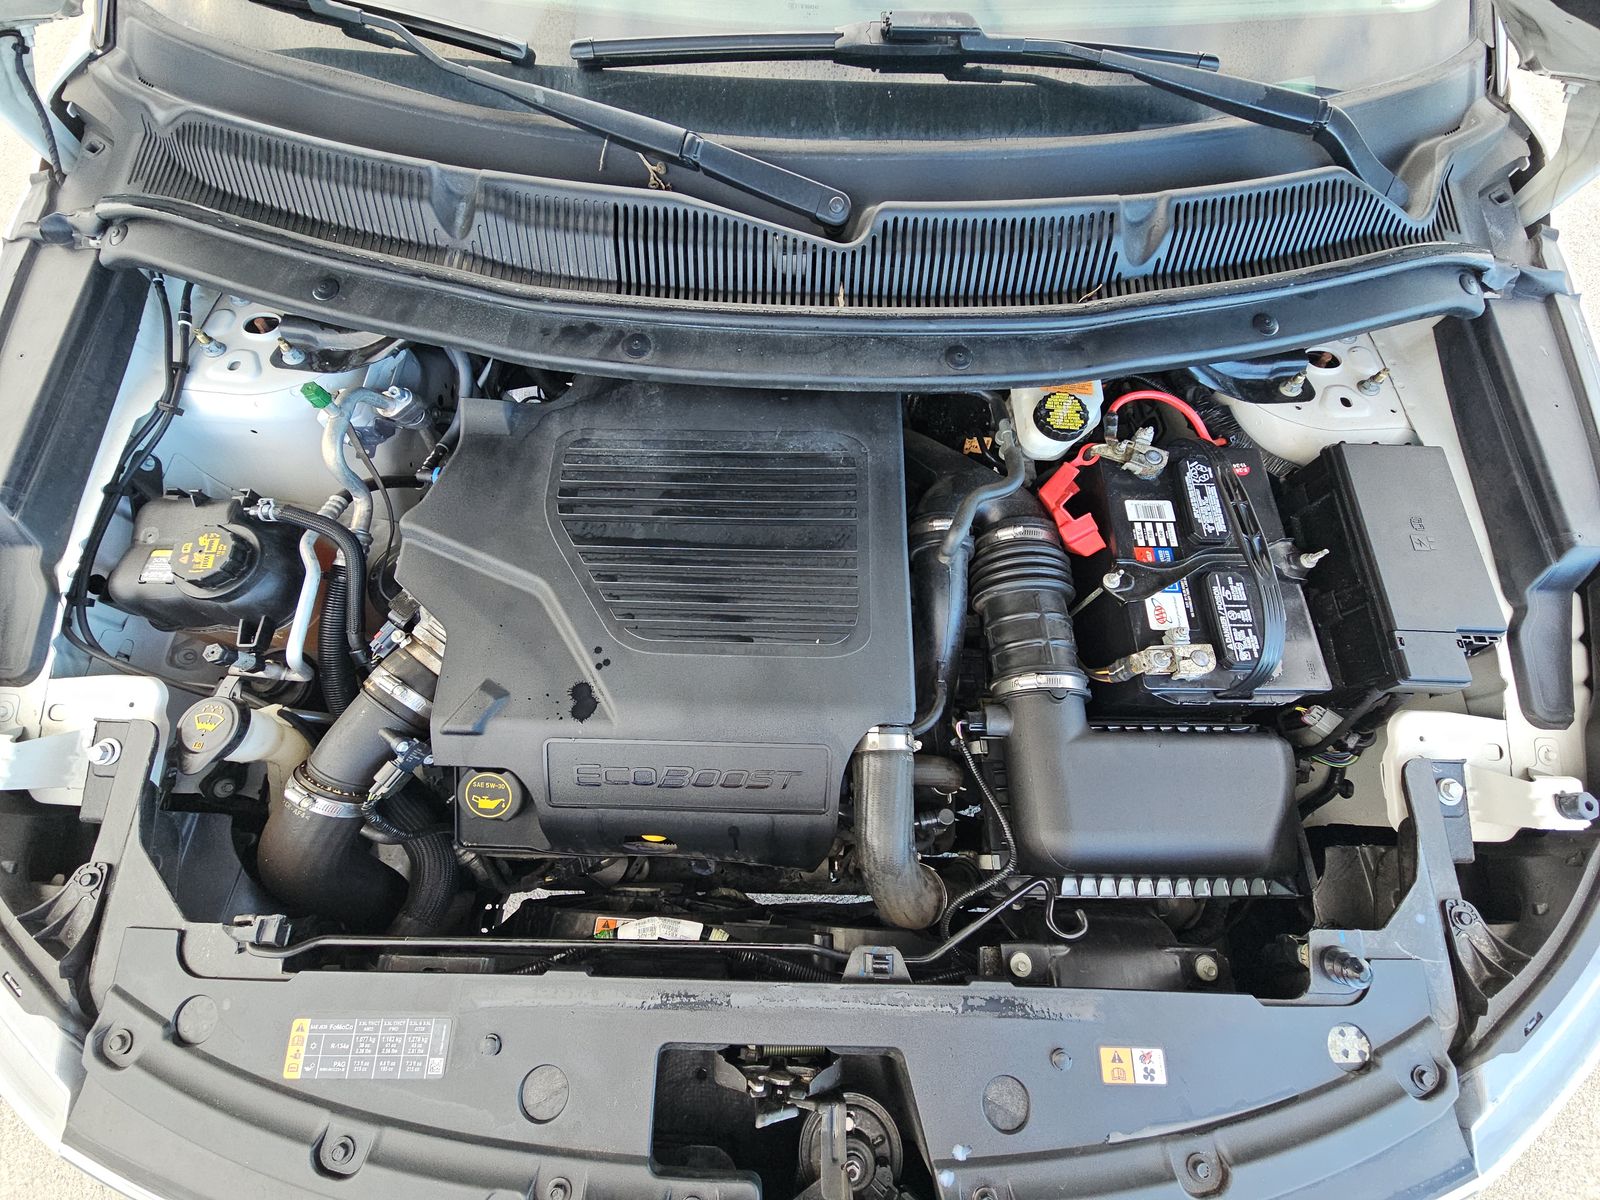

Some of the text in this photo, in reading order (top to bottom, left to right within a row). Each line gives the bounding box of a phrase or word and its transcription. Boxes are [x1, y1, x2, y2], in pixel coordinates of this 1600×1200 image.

[1212, 586, 1223, 610] POISON
[1154, 605, 1167, 624] AAA
[1220, 616, 1231, 643] DANGER
[485, 782, 506, 790] 5W-30
